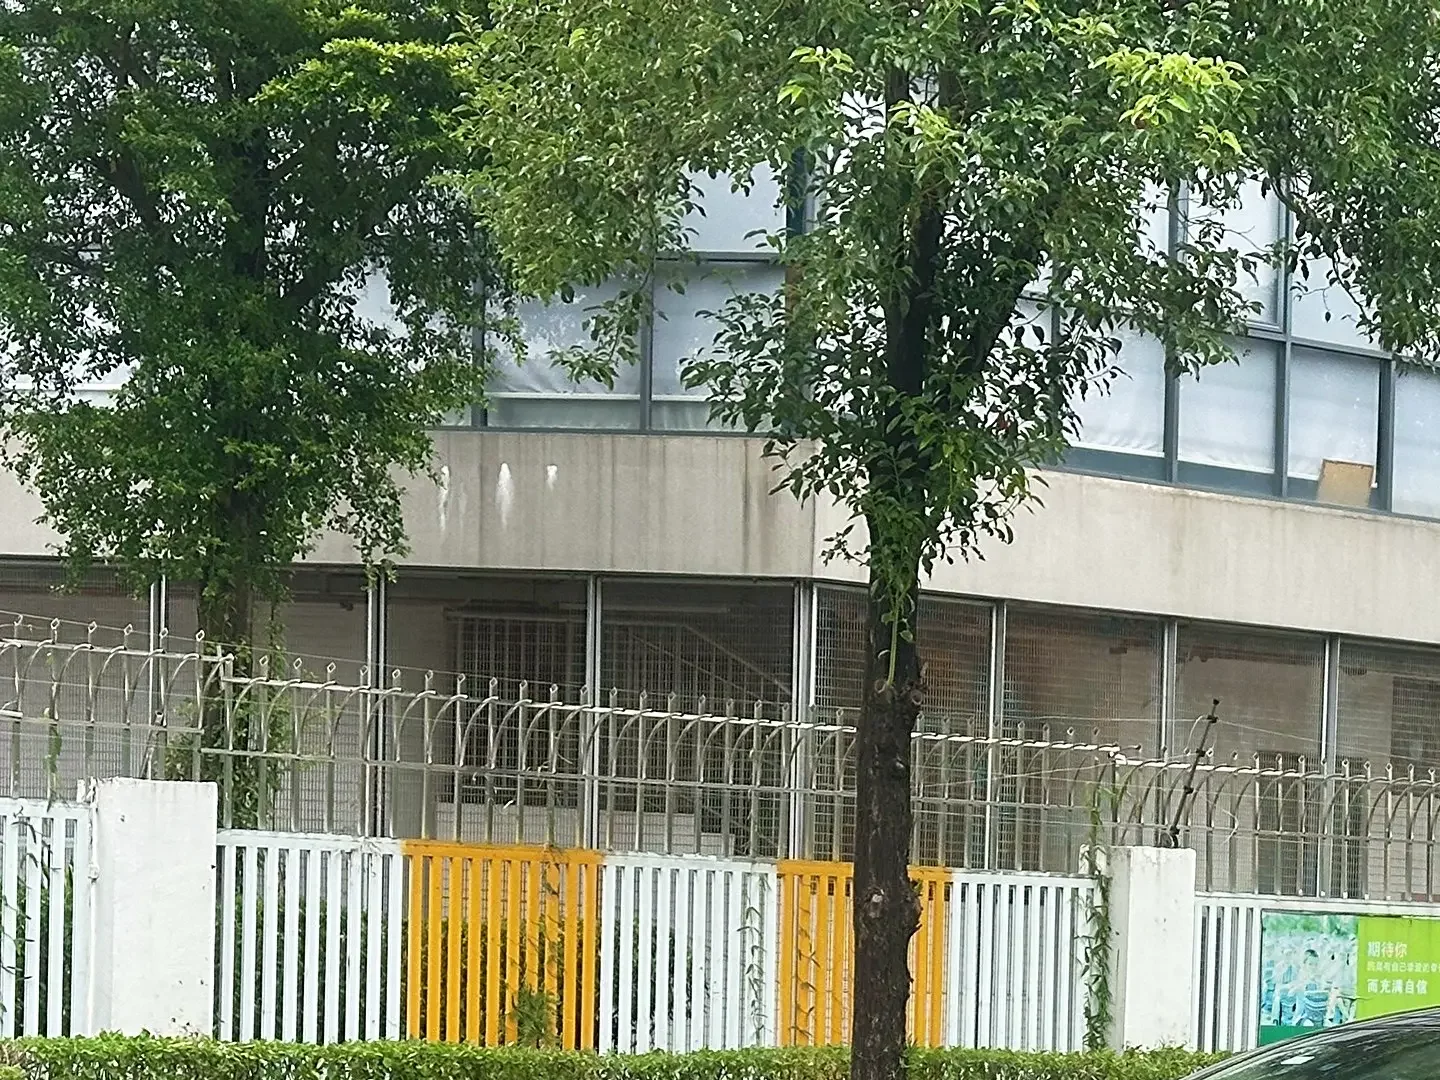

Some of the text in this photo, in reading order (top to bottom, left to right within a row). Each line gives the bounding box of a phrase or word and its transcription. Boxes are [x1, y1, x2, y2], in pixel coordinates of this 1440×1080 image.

[1367, 941, 1407, 959] 期待你
[1367, 978, 1428, 994] 而充满自信
